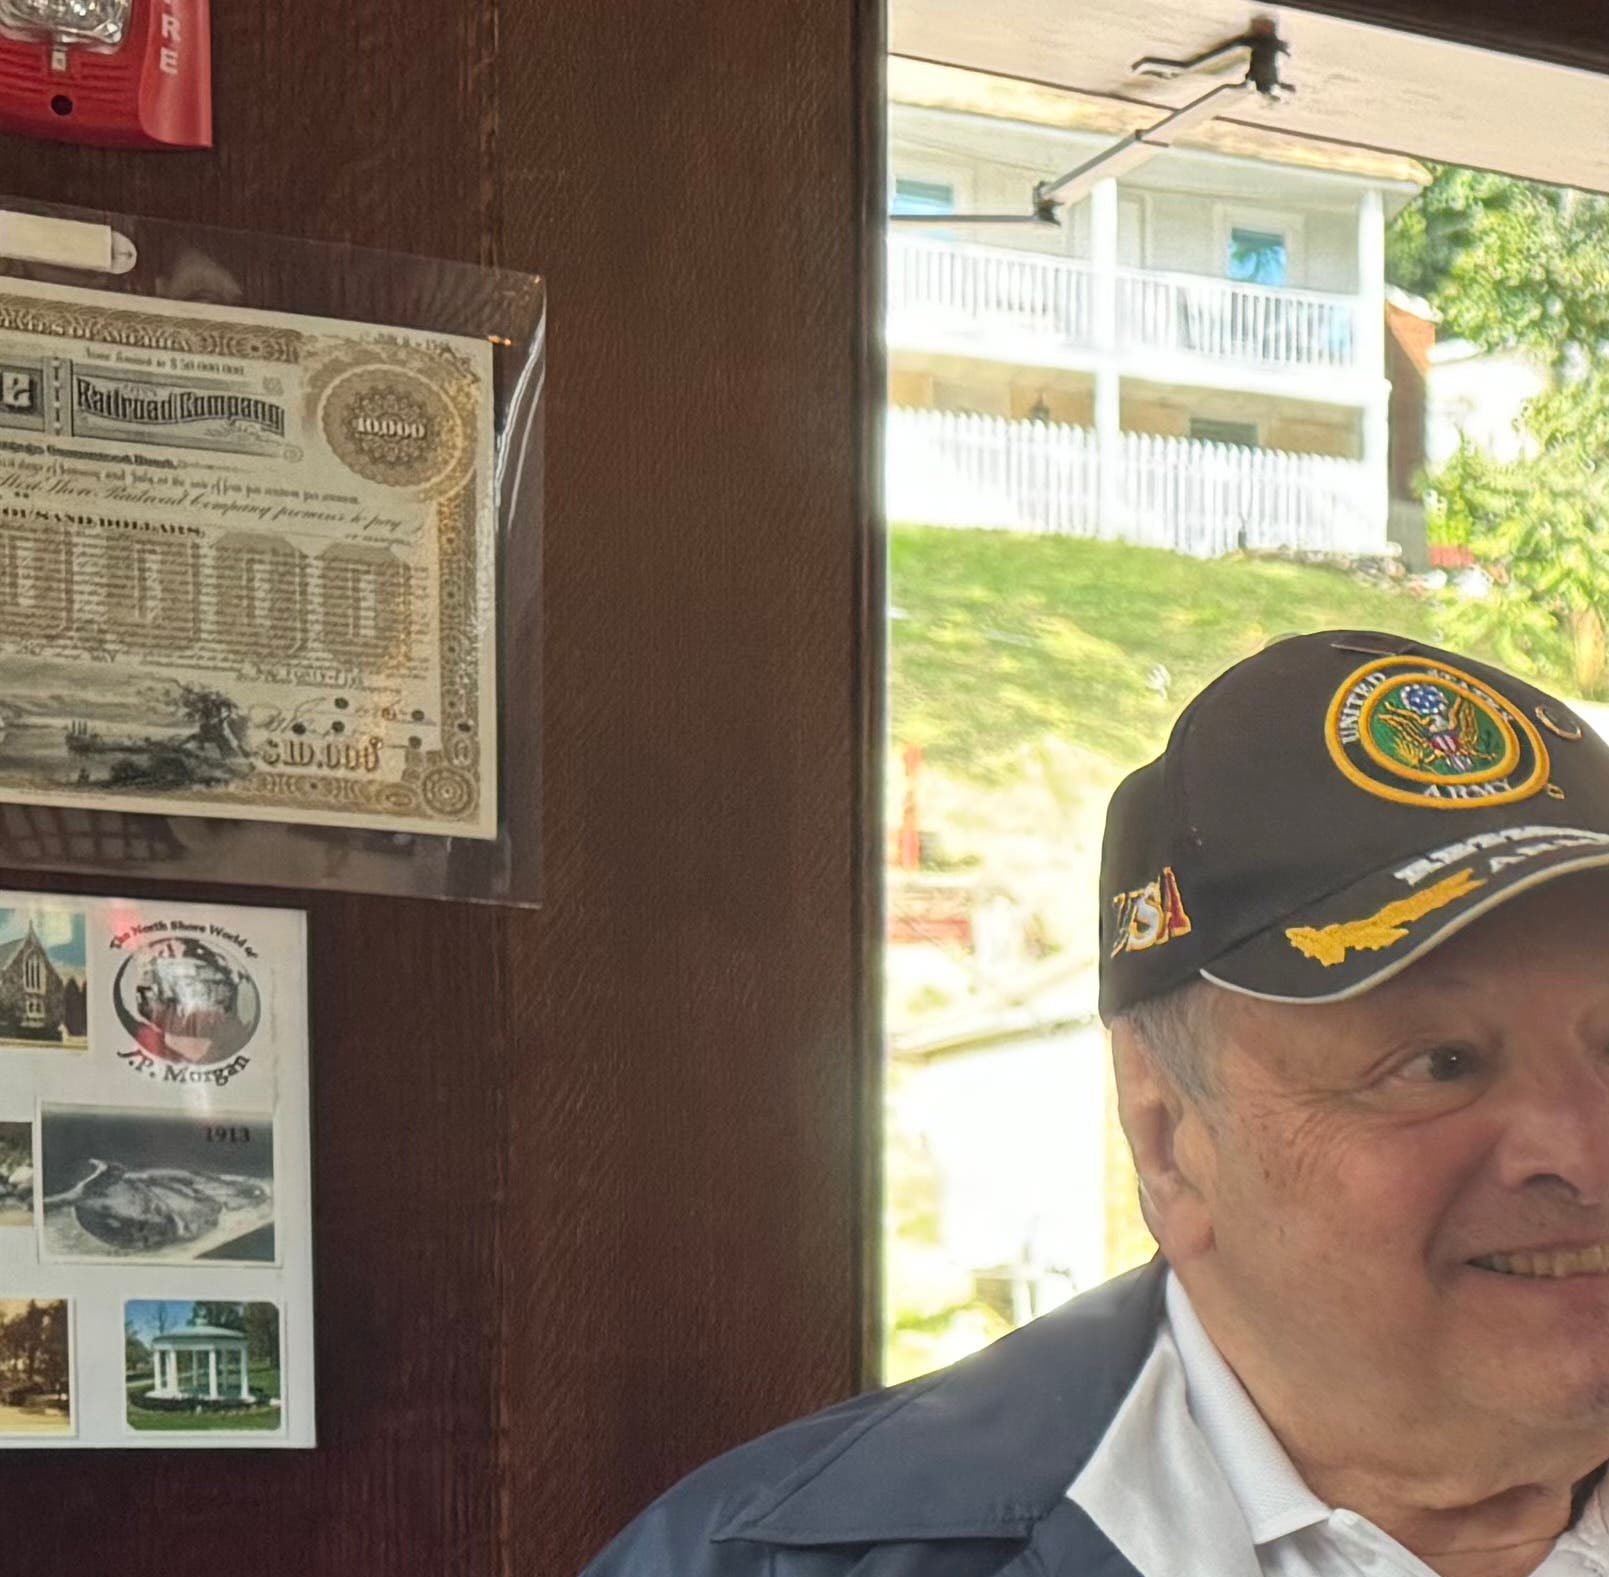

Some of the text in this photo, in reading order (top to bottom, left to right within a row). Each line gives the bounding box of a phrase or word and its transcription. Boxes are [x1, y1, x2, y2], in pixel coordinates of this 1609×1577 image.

[1339, 671, 1387, 745] UNITED
[1422, 777, 1513, 800] ARMY
[110, 932, 130, 949] The
[131, 920, 168, 936] North
[170, 919, 206, 933] Shore
[209, 924, 247, 948] World
[163, 1053, 251, 1087] Morgan
[205, 1126, 251, 1144] 1913
